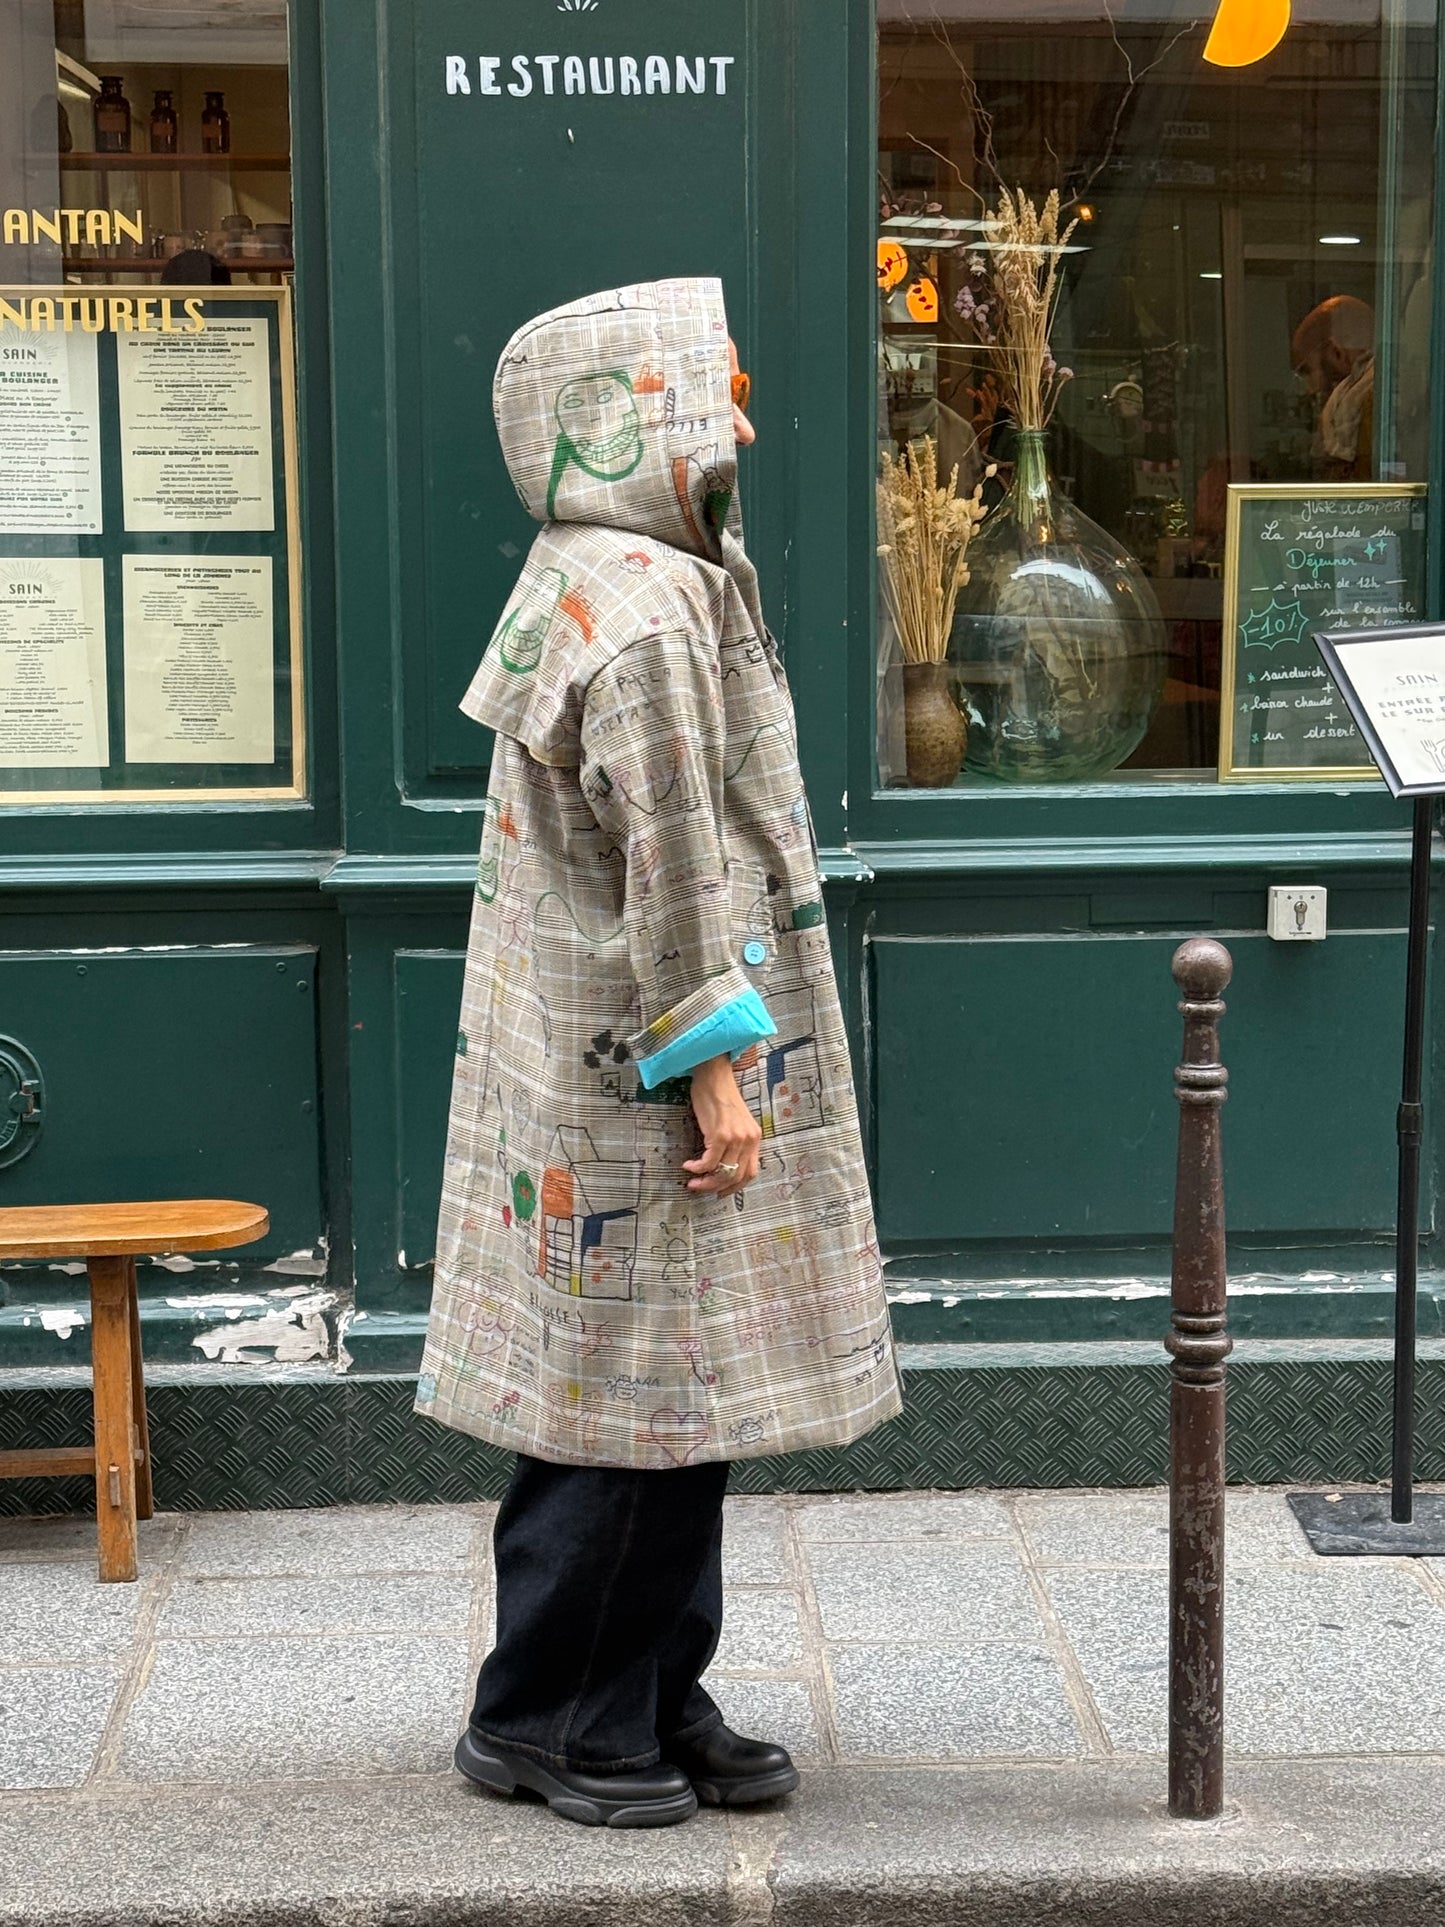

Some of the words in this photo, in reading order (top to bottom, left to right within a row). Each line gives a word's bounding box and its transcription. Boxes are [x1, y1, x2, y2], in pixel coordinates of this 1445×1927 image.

[445, 55, 735, 97] RESTAURANT
[3, 209, 144, 245] ANTAN
[0, 297, 206, 333] NATURELS
[3, 348, 37, 360] SAIN
[1260, 520, 1285, 541] La
[1295, 525, 1361, 550] régalade
[1370, 525, 1397, 539] du
[1285, 548, 1358, 579] Déjeuner
[9, 583, 43, 595] SAIN
[1291, 580, 1332, 597] partir
[1336, 576, 1351, 589] de
[1356, 576, 1381, 589] 12h
[1318, 607, 1346, 617] sur
[1247, 611, 1298, 640] -10%
[1328, 617, 1351, 630] de
[1360, 616, 1379, 628] la
[1396, 673, 1438, 686] SAIN
[1294, 696, 1334, 709] chaude
[1378, 696, 1432, 709] ENTRÉE
[1404, 707, 1434, 716] SUR
[1262, 730, 1285, 741] un
[1302, 723, 1356, 739] dessert
